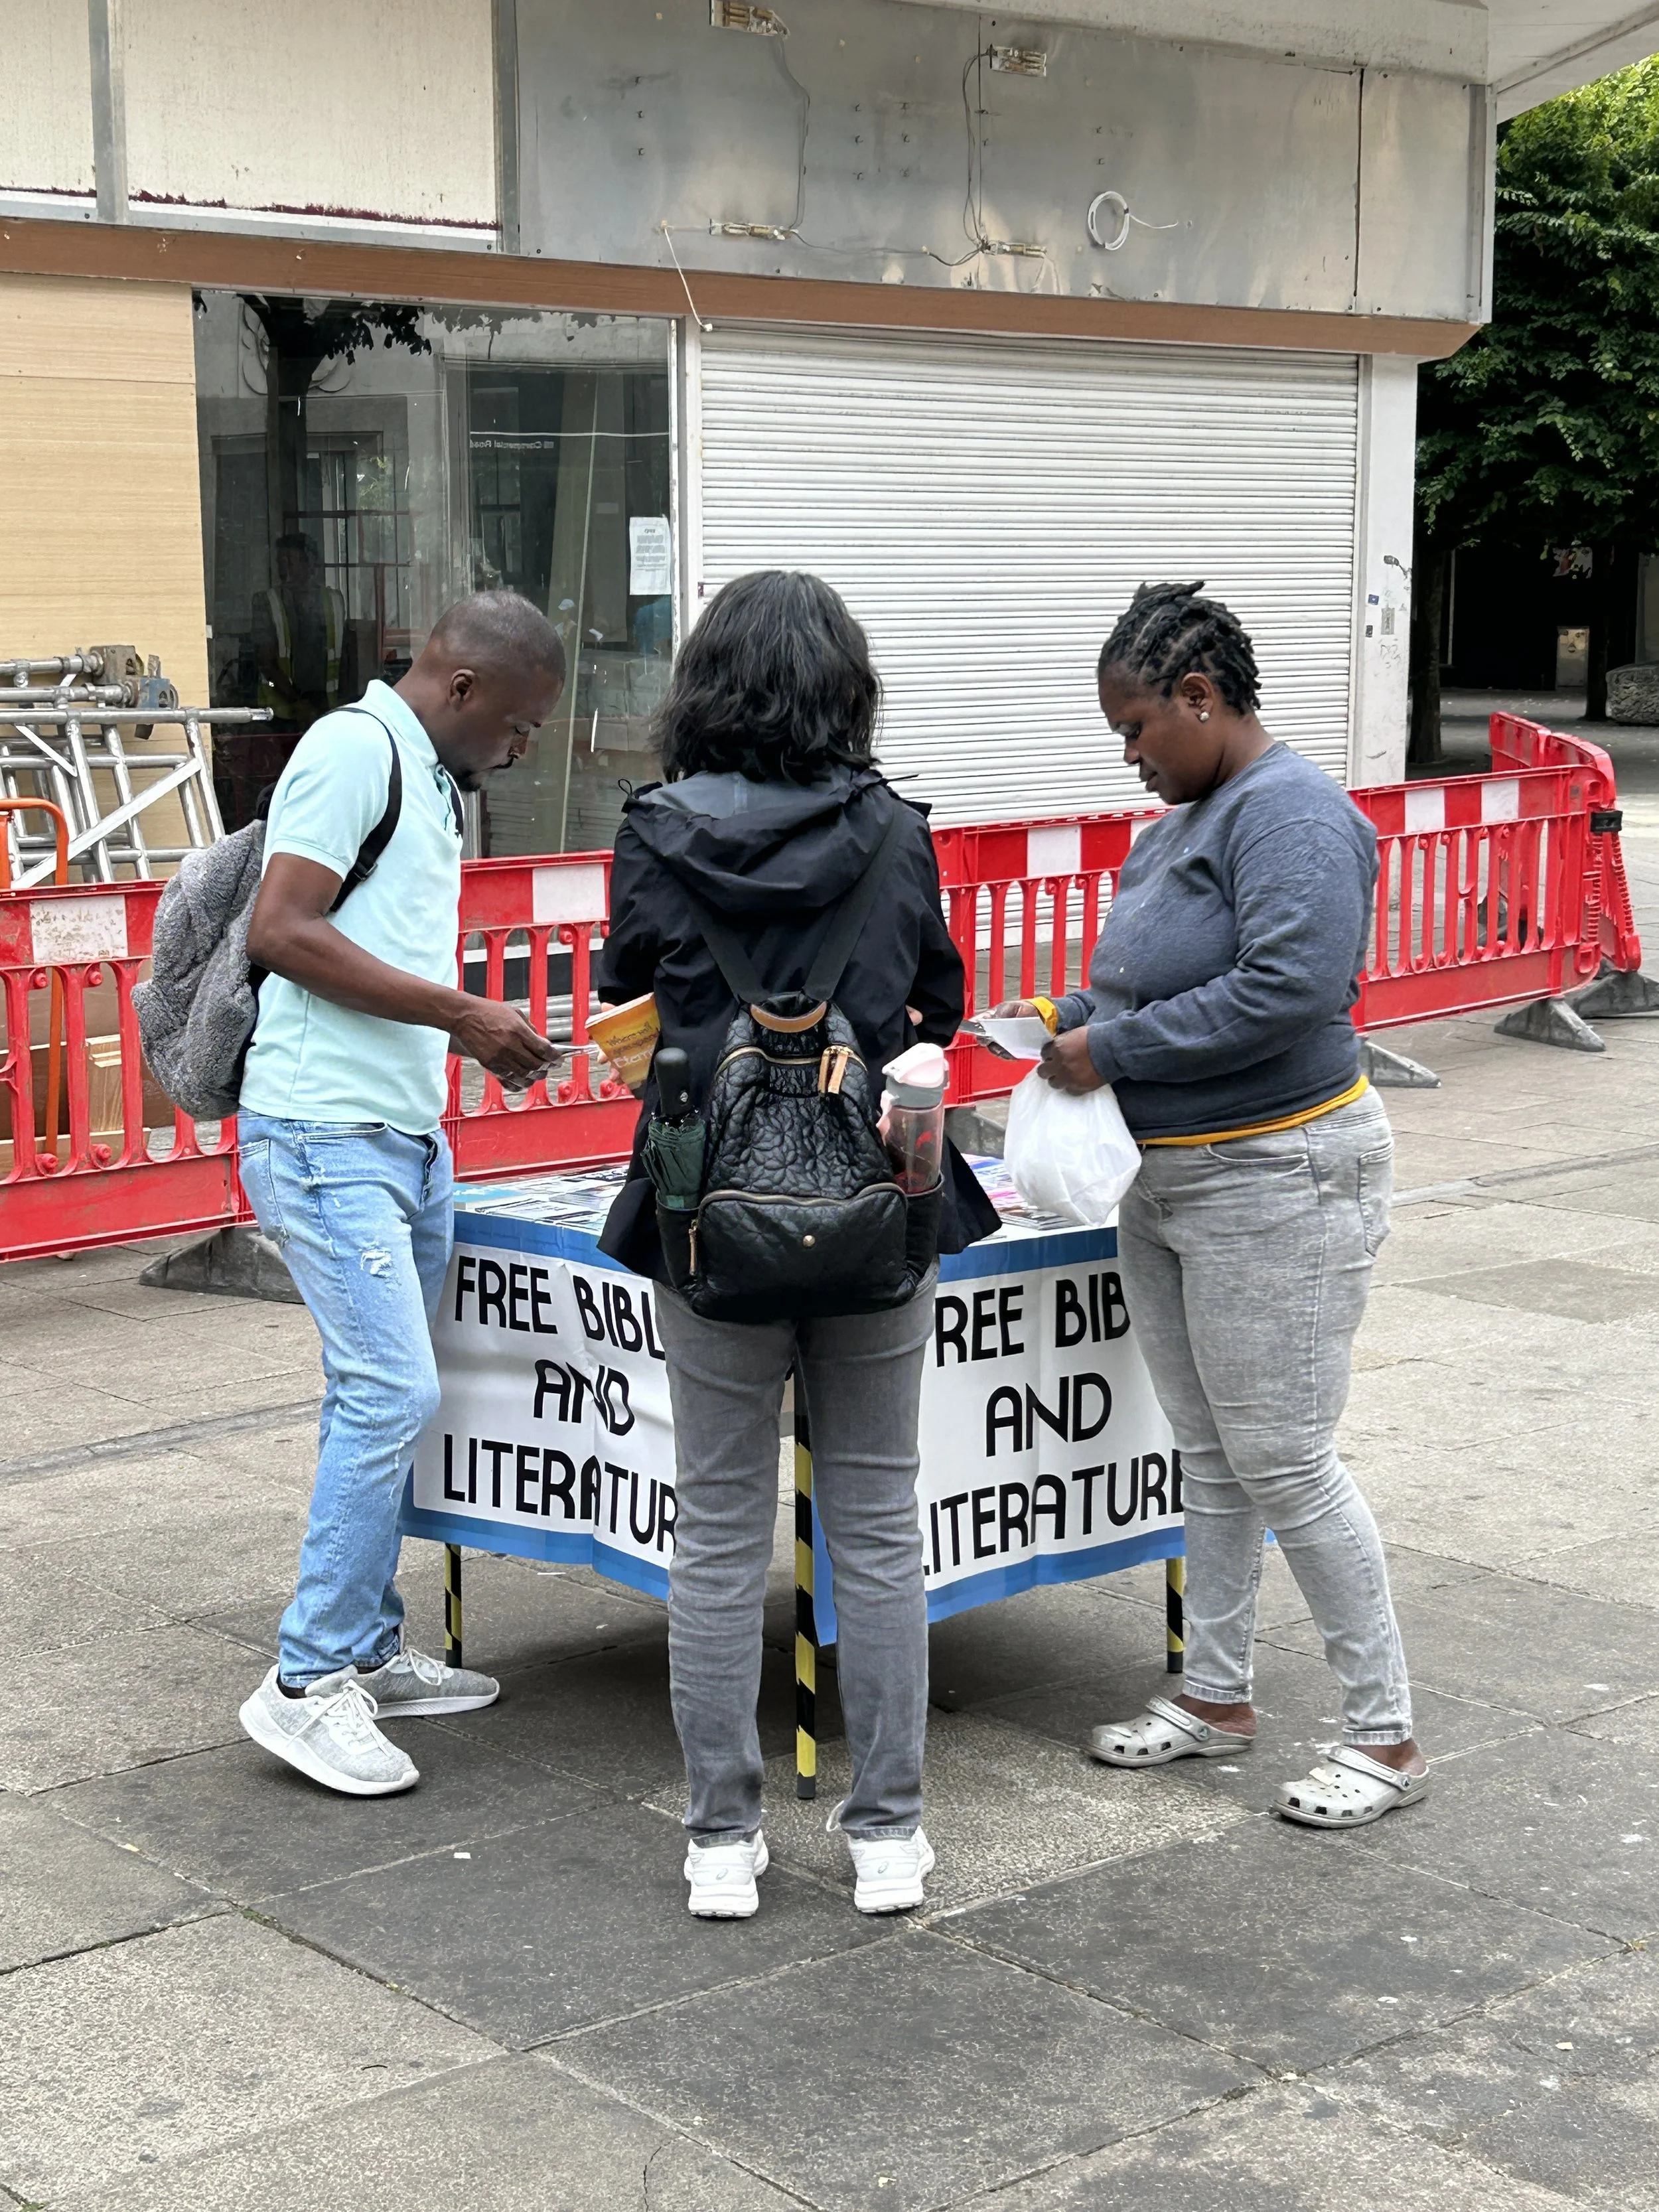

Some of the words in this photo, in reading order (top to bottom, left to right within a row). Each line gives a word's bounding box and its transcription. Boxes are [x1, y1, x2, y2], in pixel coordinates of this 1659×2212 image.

[455, 1254, 558, 1335] FREE
[573, 1275, 666, 1361] BIBL
[934, 1285, 1024, 1367] REE
[1055, 1271, 1131, 1348] BIB
[534, 1359, 635, 1436] AND
[986, 1372, 1112, 1457] AND
[443, 1434, 678, 1556] LITERATUR
